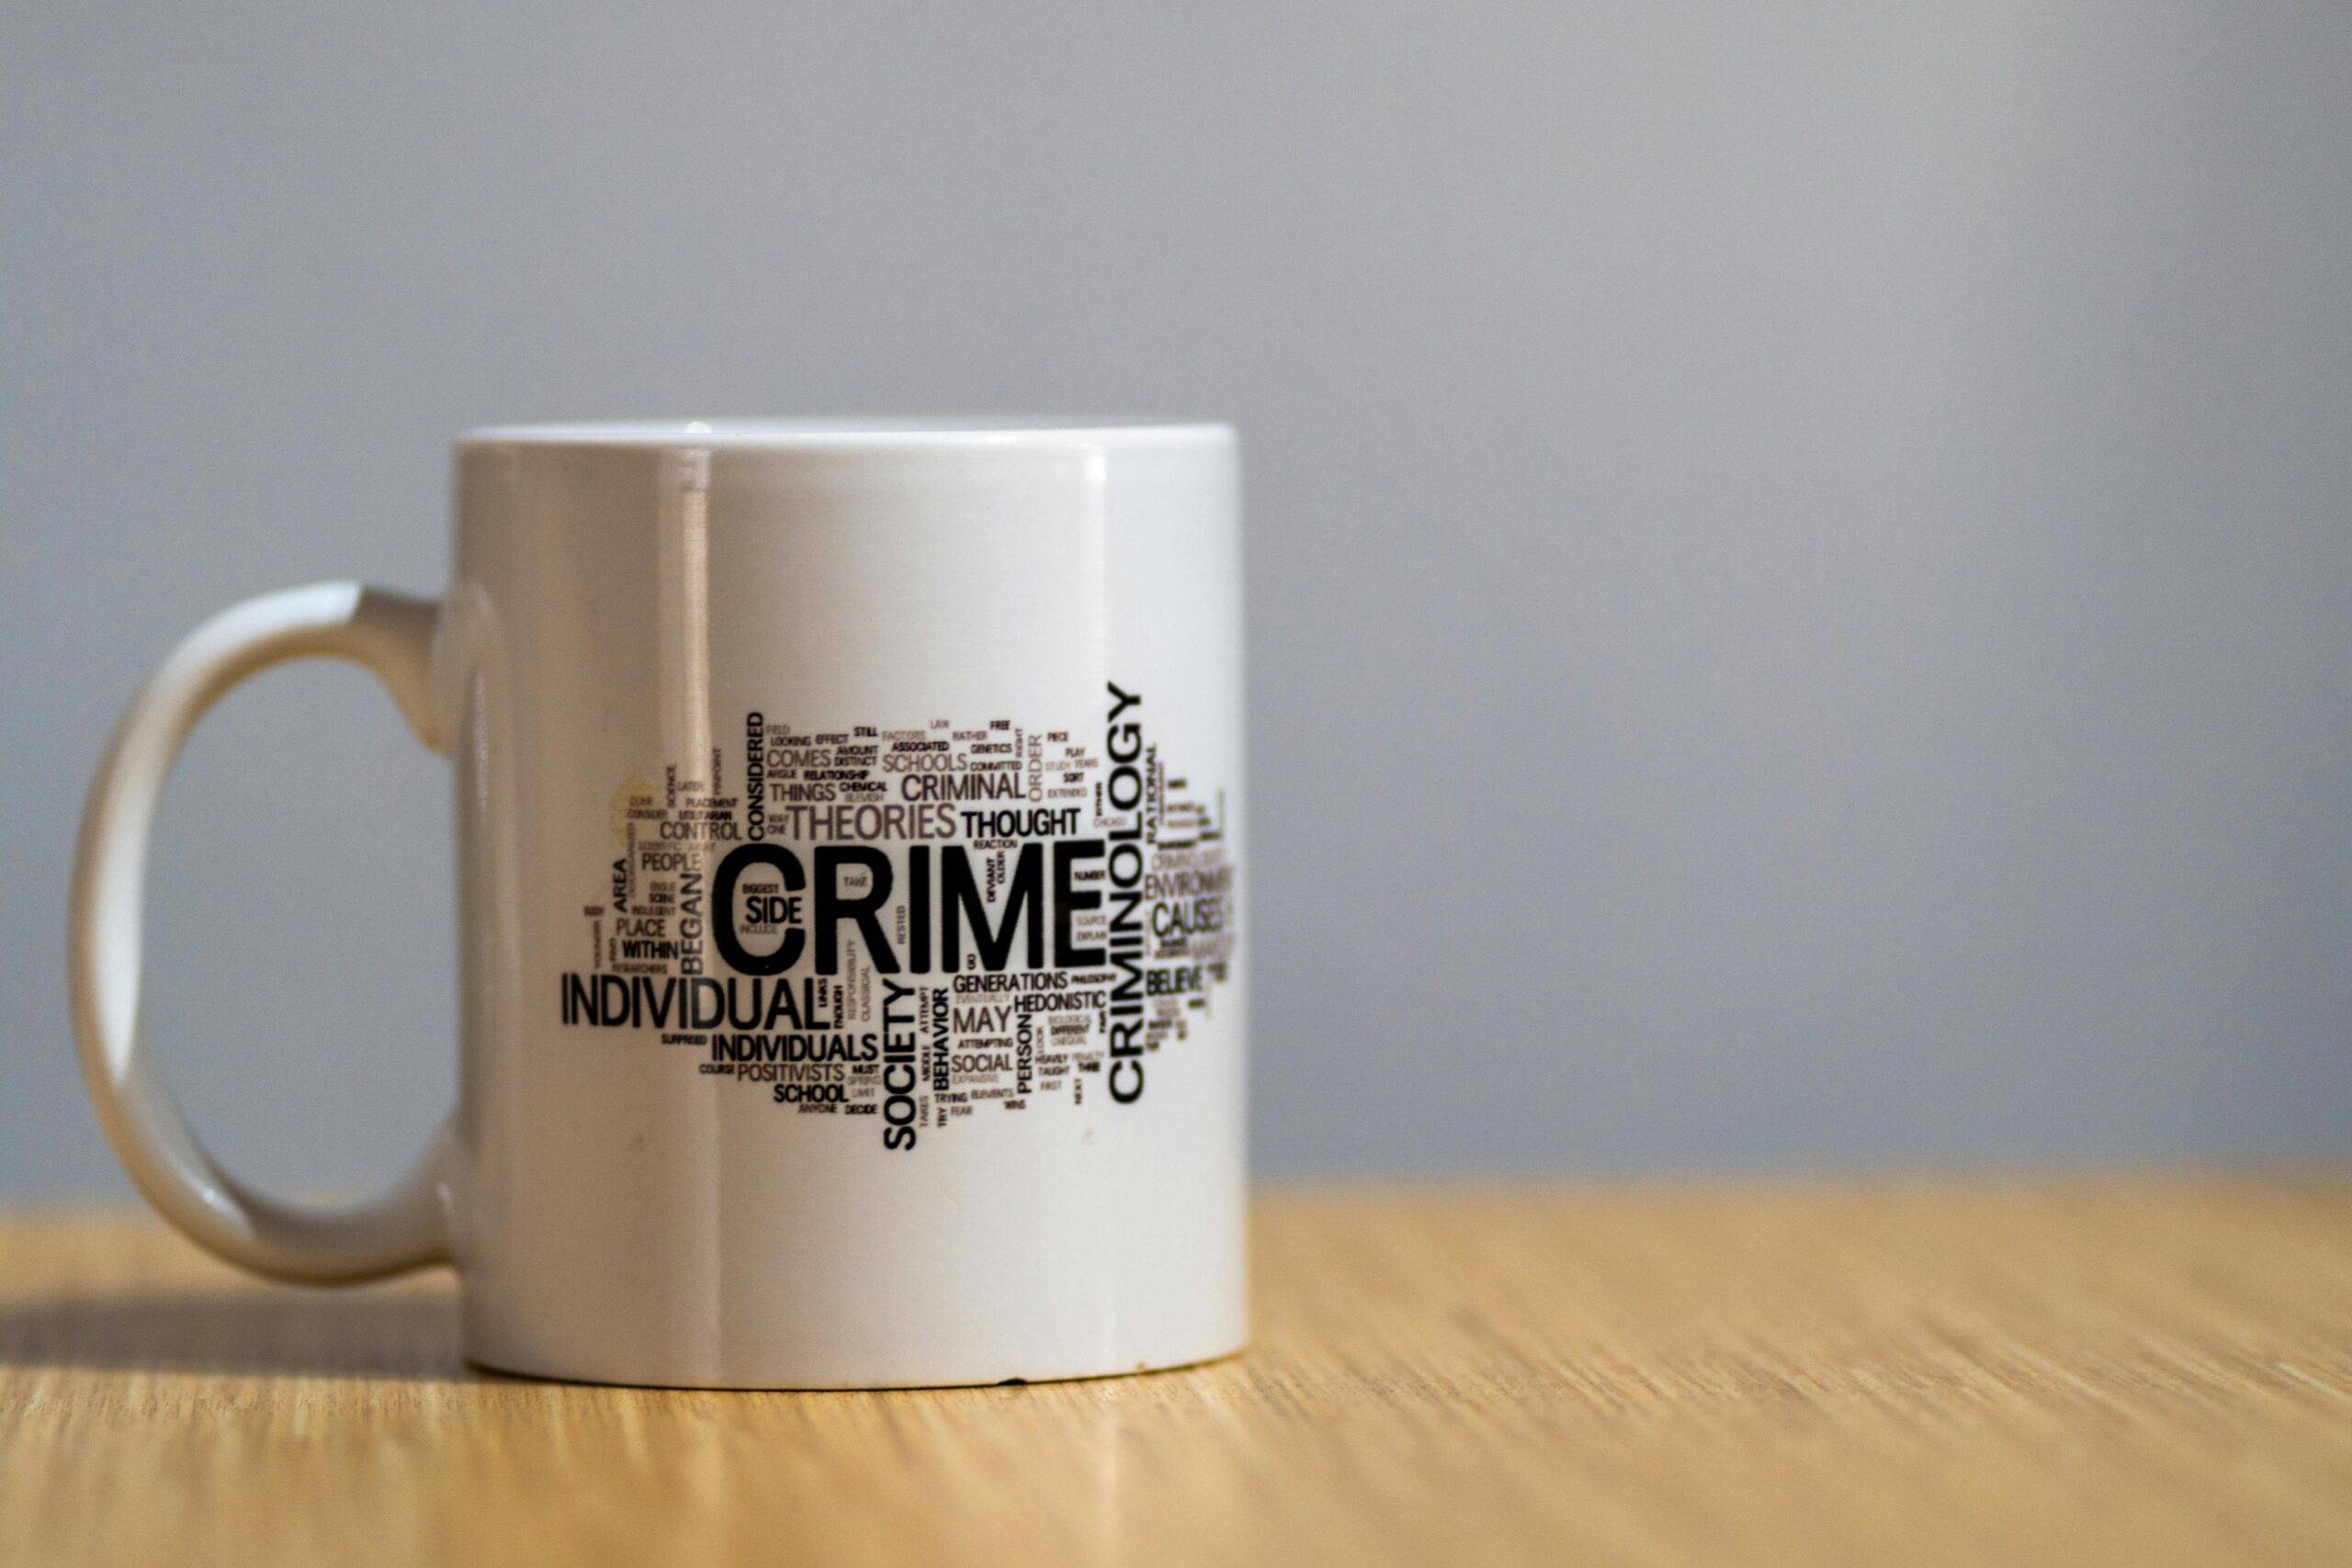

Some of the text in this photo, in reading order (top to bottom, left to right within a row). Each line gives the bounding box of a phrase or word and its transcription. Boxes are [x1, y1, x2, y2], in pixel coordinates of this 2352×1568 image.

[766, 725, 790, 735] FIELD
[854, 727, 877, 737] STILL
[990, 720, 1010, 730] FREE
[770, 736, 810, 747] LOOKING
[816, 734, 848, 744] EFFECT
[953, 730, 988, 740] RATHER
[1014, 728, 1023, 758] RIGHT
[1047, 732, 1069, 742] PIECE
[836, 745, 878, 755] AMOUNT
[892, 741, 949, 751] ASSOCIATED
[970, 743, 1012, 754] GENETICS
[1065, 748, 1084, 758] PLAY
[766, 750, 831, 768] COMES
[834, 756, 877, 767] DISTINCT
[882, 753, 967, 773] SCHOOLS
[969, 761, 1022, 771] COMMITTED
[1028, 735, 1042, 802] ORDER
[1075, 759, 1098, 769] YEARS
[747, 712, 763, 840] CONSIDERED
[766, 770, 797, 779] ARGUE
[803, 770, 869, 781] RELATIONSHIP
[1063, 773, 1084, 783] SORT
[666, 765, 675, 807] SCIENCE
[677, 781, 704, 792] LATER
[770, 783, 836, 802] THINGS
[839, 782, 888, 792] CHEMICAL
[901, 772, 1025, 801] CRIMINAL
[1047, 788, 1087, 798] EXTENDED
[1146, 743, 1156, 844] RATIONAL
[685, 797, 738, 808] PLACEMENT
[679, 810, 732, 820] UTILITARIAN
[785, 803, 956, 840] THEORIES
[960, 808, 1081, 838] THOUGHT
[659, 821, 741, 840] CONTROL
[973, 840, 1017, 850] REACTION
[641, 852, 700, 872] PEOPLE
[997, 852, 1006, 885] OLDER
[843, 875, 867, 886] TAKE
[986, 858, 996, 903] DEVIANT
[1074, 870, 1105, 881] NUMBER
[613, 858, 627, 913] AREA
[742, 884, 779, 894] BIGGEST
[1106, 682, 1142, 1103] CRIMINOLOGY
[711, 839, 1106, 976] CRIME
[745, 896, 802, 924] SIDE
[616, 919, 665, 937] PLACE
[680, 873, 703, 975] BEGAN
[897, 906, 906, 944] RESTED
[622, 940, 678, 959] WITHIN
[967, 953, 976, 970] GO
[846, 939, 855, 1021] RESPONSIBILITY
[953, 972, 1068, 993] GENERATIONS
[1071, 974, 1116, 985] PHILOSOPHY
[1147, 964, 1203, 997] BELIEVE
[561, 973, 830, 1031] INDIVIDUAL
[818, 978, 827, 1007] LINKS
[860, 965, 870, 1021] CLASSICAL
[1014, 990, 1106, 1012] HEDONISTIC
[833, 986, 843, 1029] ENOUGH
[920, 987, 929, 1033] ATTEMPT
[953, 1006, 1011, 1033] MAY
[933, 987, 949, 1090] BEHAVIOR
[1050, 1024, 1090, 1035] DIFFERENT
[662, 1034, 707, 1045] SURPRISED
[712, 1033, 878, 1062] INDIVIDUALS
[957, 1038, 1012, 1049] ATTEMPTING
[1017, 1013, 1033, 1094] PERSON
[699, 1064, 734, 1074] COURSE
[737, 1063, 845, 1082] POSITIVISTS
[853, 1064, 879, 1075] MUST
[883, 978, 916, 1151] SOCIETY
[922, 1045, 931, 1082] MIDDLE
[951, 1054, 1013, 1073] SOCIAL
[1038, 1066, 1069, 1077] TAUGHT
[774, 1084, 849, 1103] SCHOOL
[1040, 1080, 1061, 1091] FIRST
[1074, 1077, 1082, 1104] NEXT
[934, 1093, 967, 1104] TRYING
[798, 1104, 837, 1114] ANYONE
[845, 1103, 877, 1114] DECIDE
[920, 1095, 929, 1128] TAKES
[937, 1106, 947, 1128] TRY
[951, 1105, 973, 1116] FEAR
